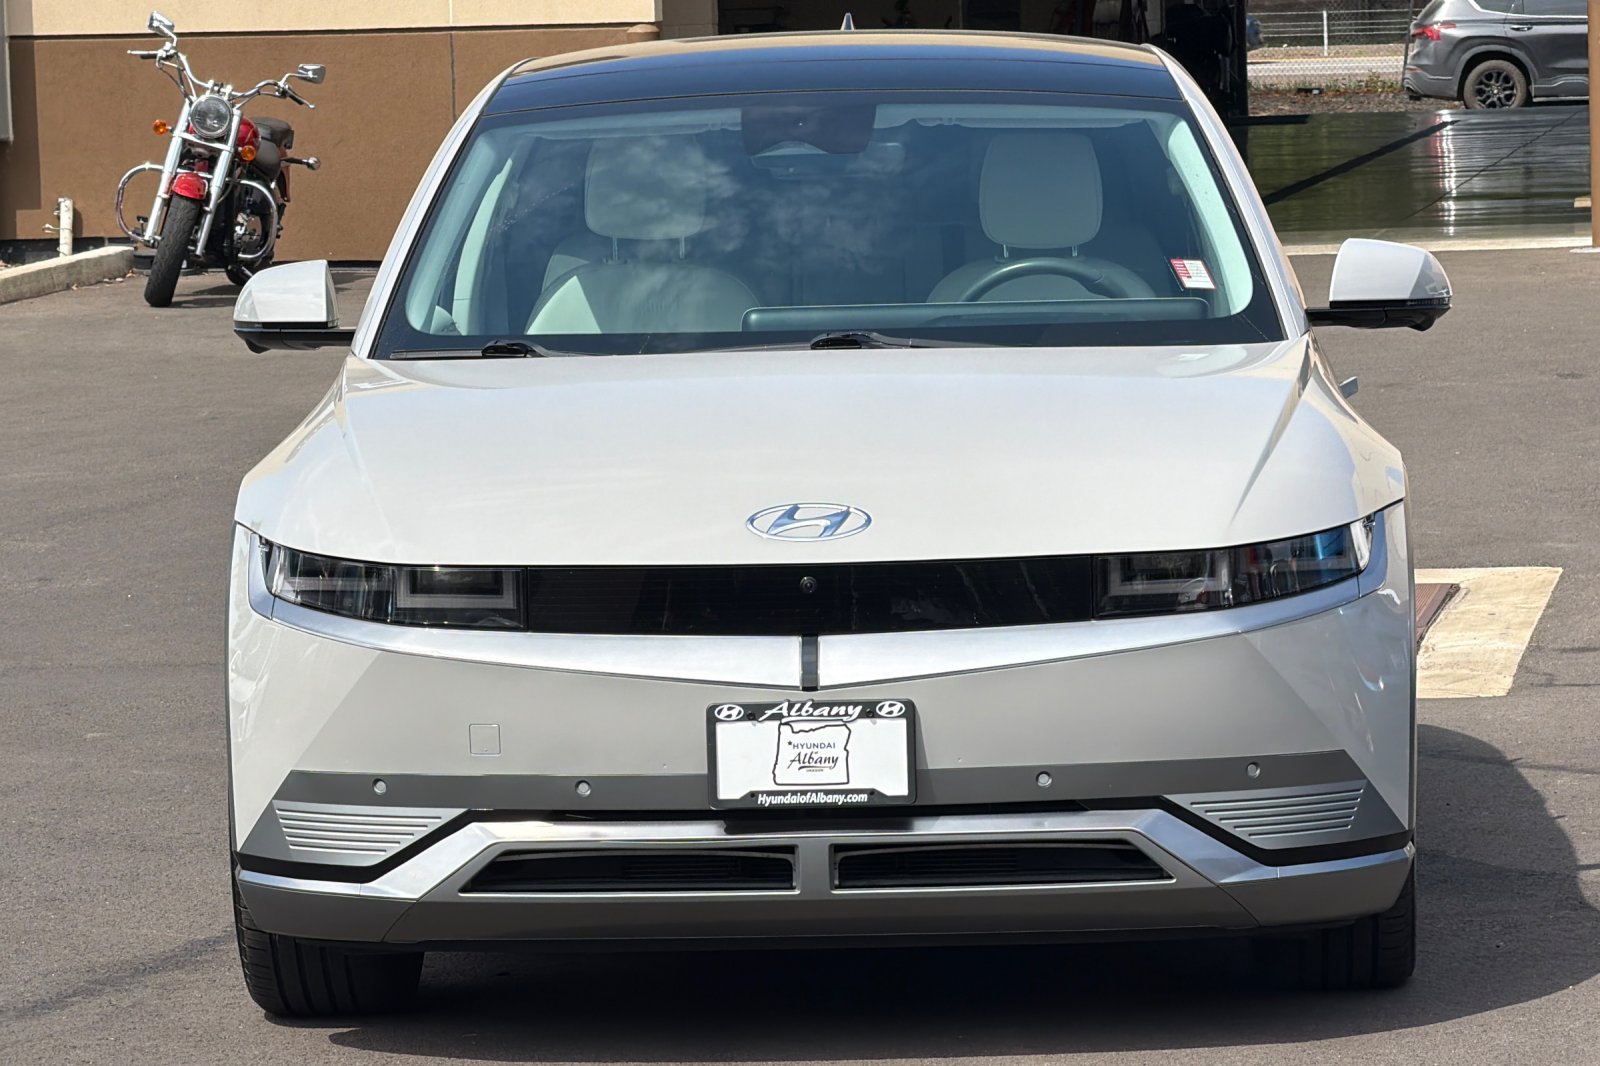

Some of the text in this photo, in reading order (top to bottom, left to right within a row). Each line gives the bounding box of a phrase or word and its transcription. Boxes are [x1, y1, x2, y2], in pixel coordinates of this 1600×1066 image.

[758, 701, 863, 723] Albany
[792, 742, 836, 750] HYUNDAI
[786, 751, 839, 770] Albany
[757, 792, 868, 807] HyundaiofAlbany.com
